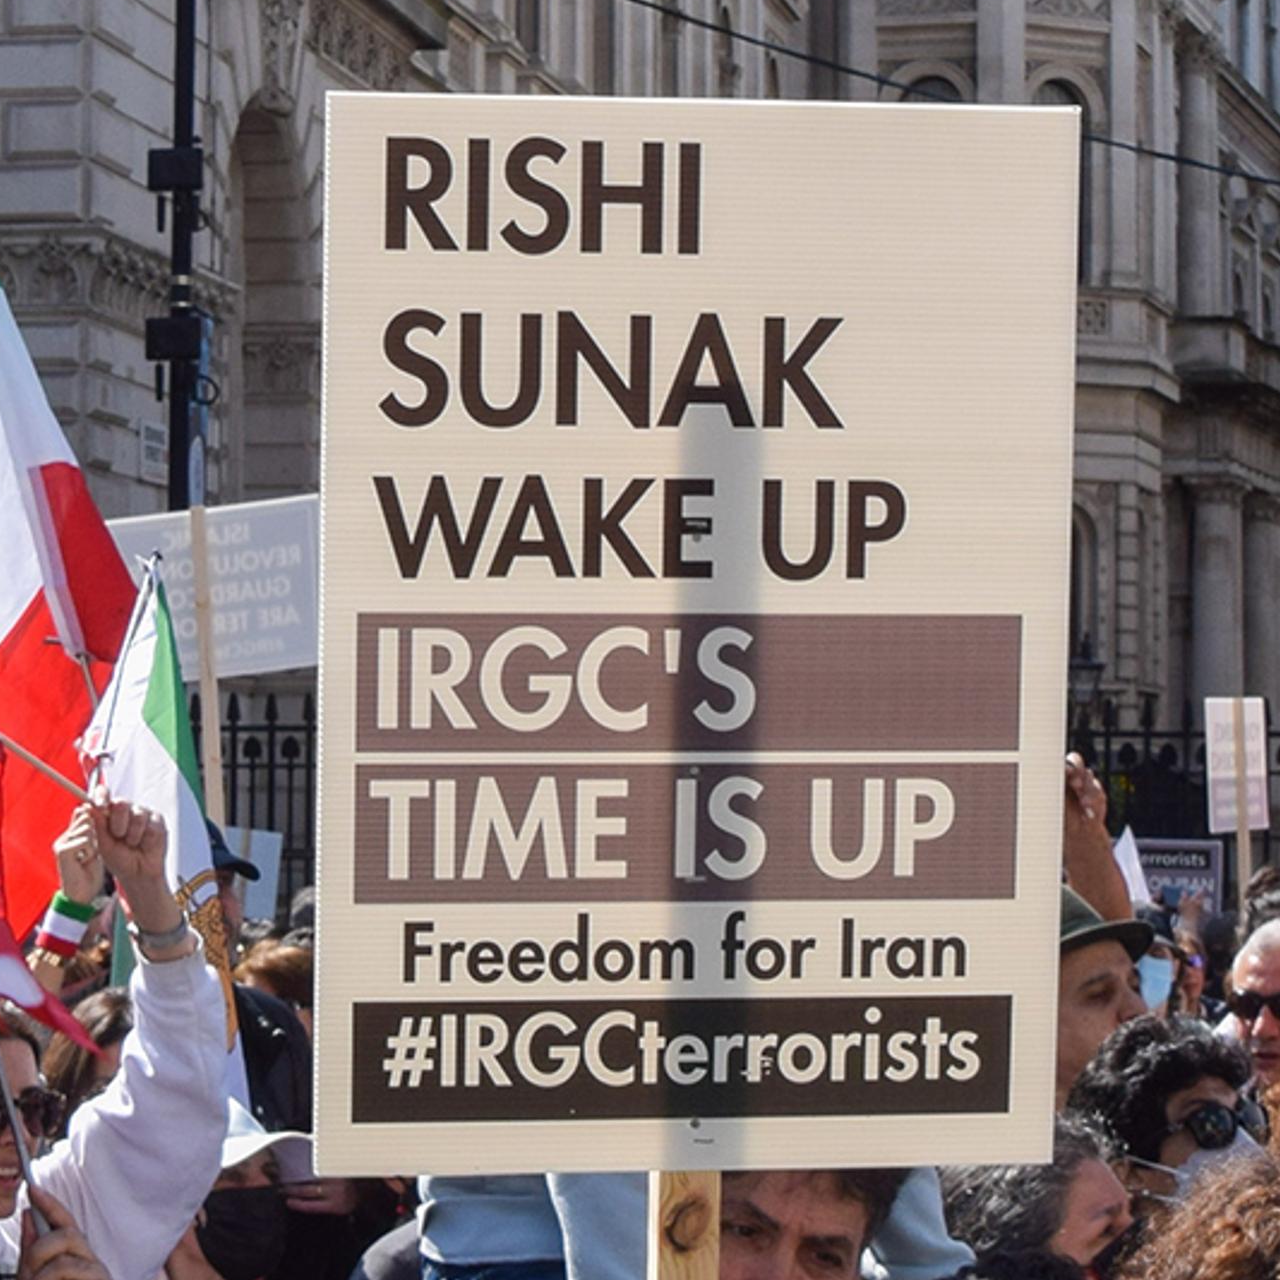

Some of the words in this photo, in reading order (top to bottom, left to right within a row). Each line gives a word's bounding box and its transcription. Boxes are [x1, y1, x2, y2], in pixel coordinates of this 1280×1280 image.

[383, 136, 701, 255] RISHI
[378, 309, 845, 429] SUNAK
[373, 475, 715, 580] WAKE
[761, 479, 907, 582] UP
[376, 625, 757, 732] IRGC'S
[369, 776, 629, 881] TIME
[673, 776, 768, 882] IS
[809, 777, 957, 880] UP
[402, 912, 696, 984] Freedom
[721, 911, 816, 980] for
[840, 917, 967, 980] Iran
[383, 1006, 982, 1088] #IRGCterrorists
